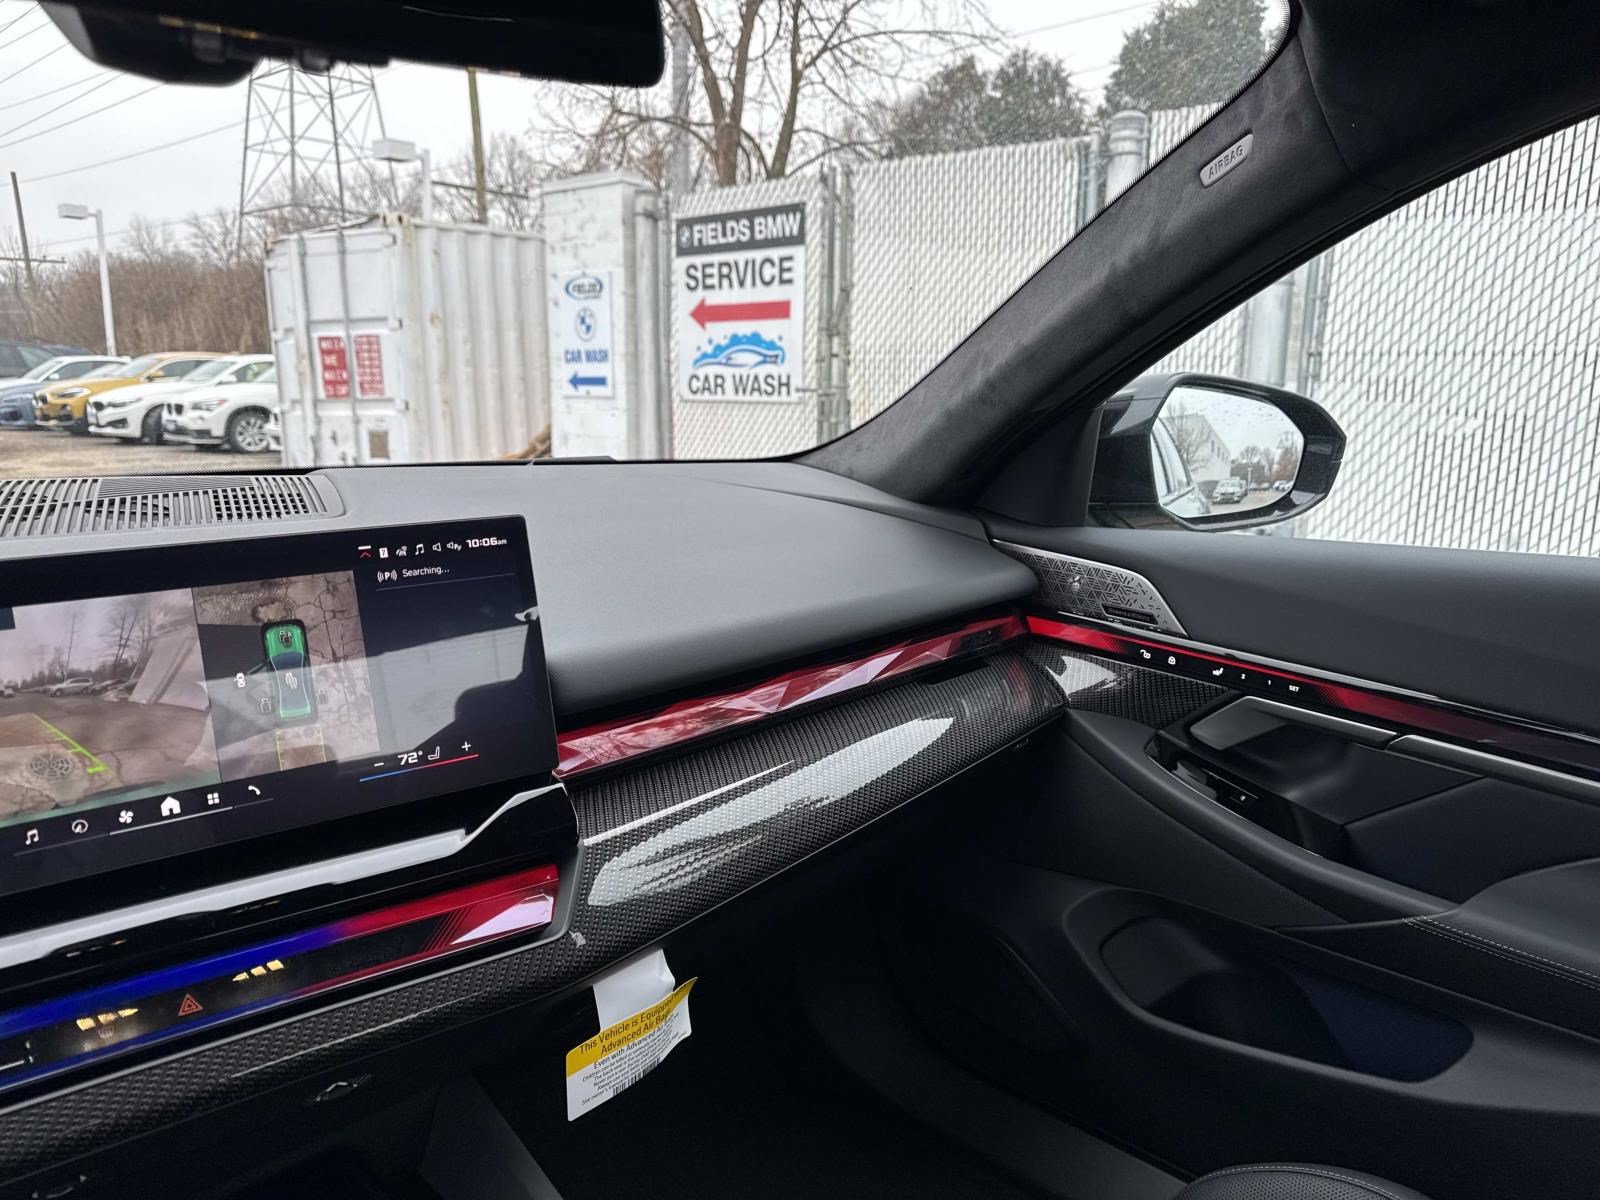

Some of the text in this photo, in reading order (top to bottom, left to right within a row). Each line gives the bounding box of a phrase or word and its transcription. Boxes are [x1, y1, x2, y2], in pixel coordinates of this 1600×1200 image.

[1208, 144, 1243, 179] AIRBAG
[692, 211, 801, 246] FIELDS BMW
[685, 256, 793, 291] SERVICE
[564, 348, 609, 363] CAR WASH
[688, 374, 791, 396] CAR WASH
[580, 1040, 598, 1055] This
[598, 1022, 630, 1043] Vehicle
[631, 1018, 639, 1028] is
[600, 1026, 642, 1056] Advanced
[643, 1020, 654, 1034] Air
[612, 1047, 624, 1060] with
